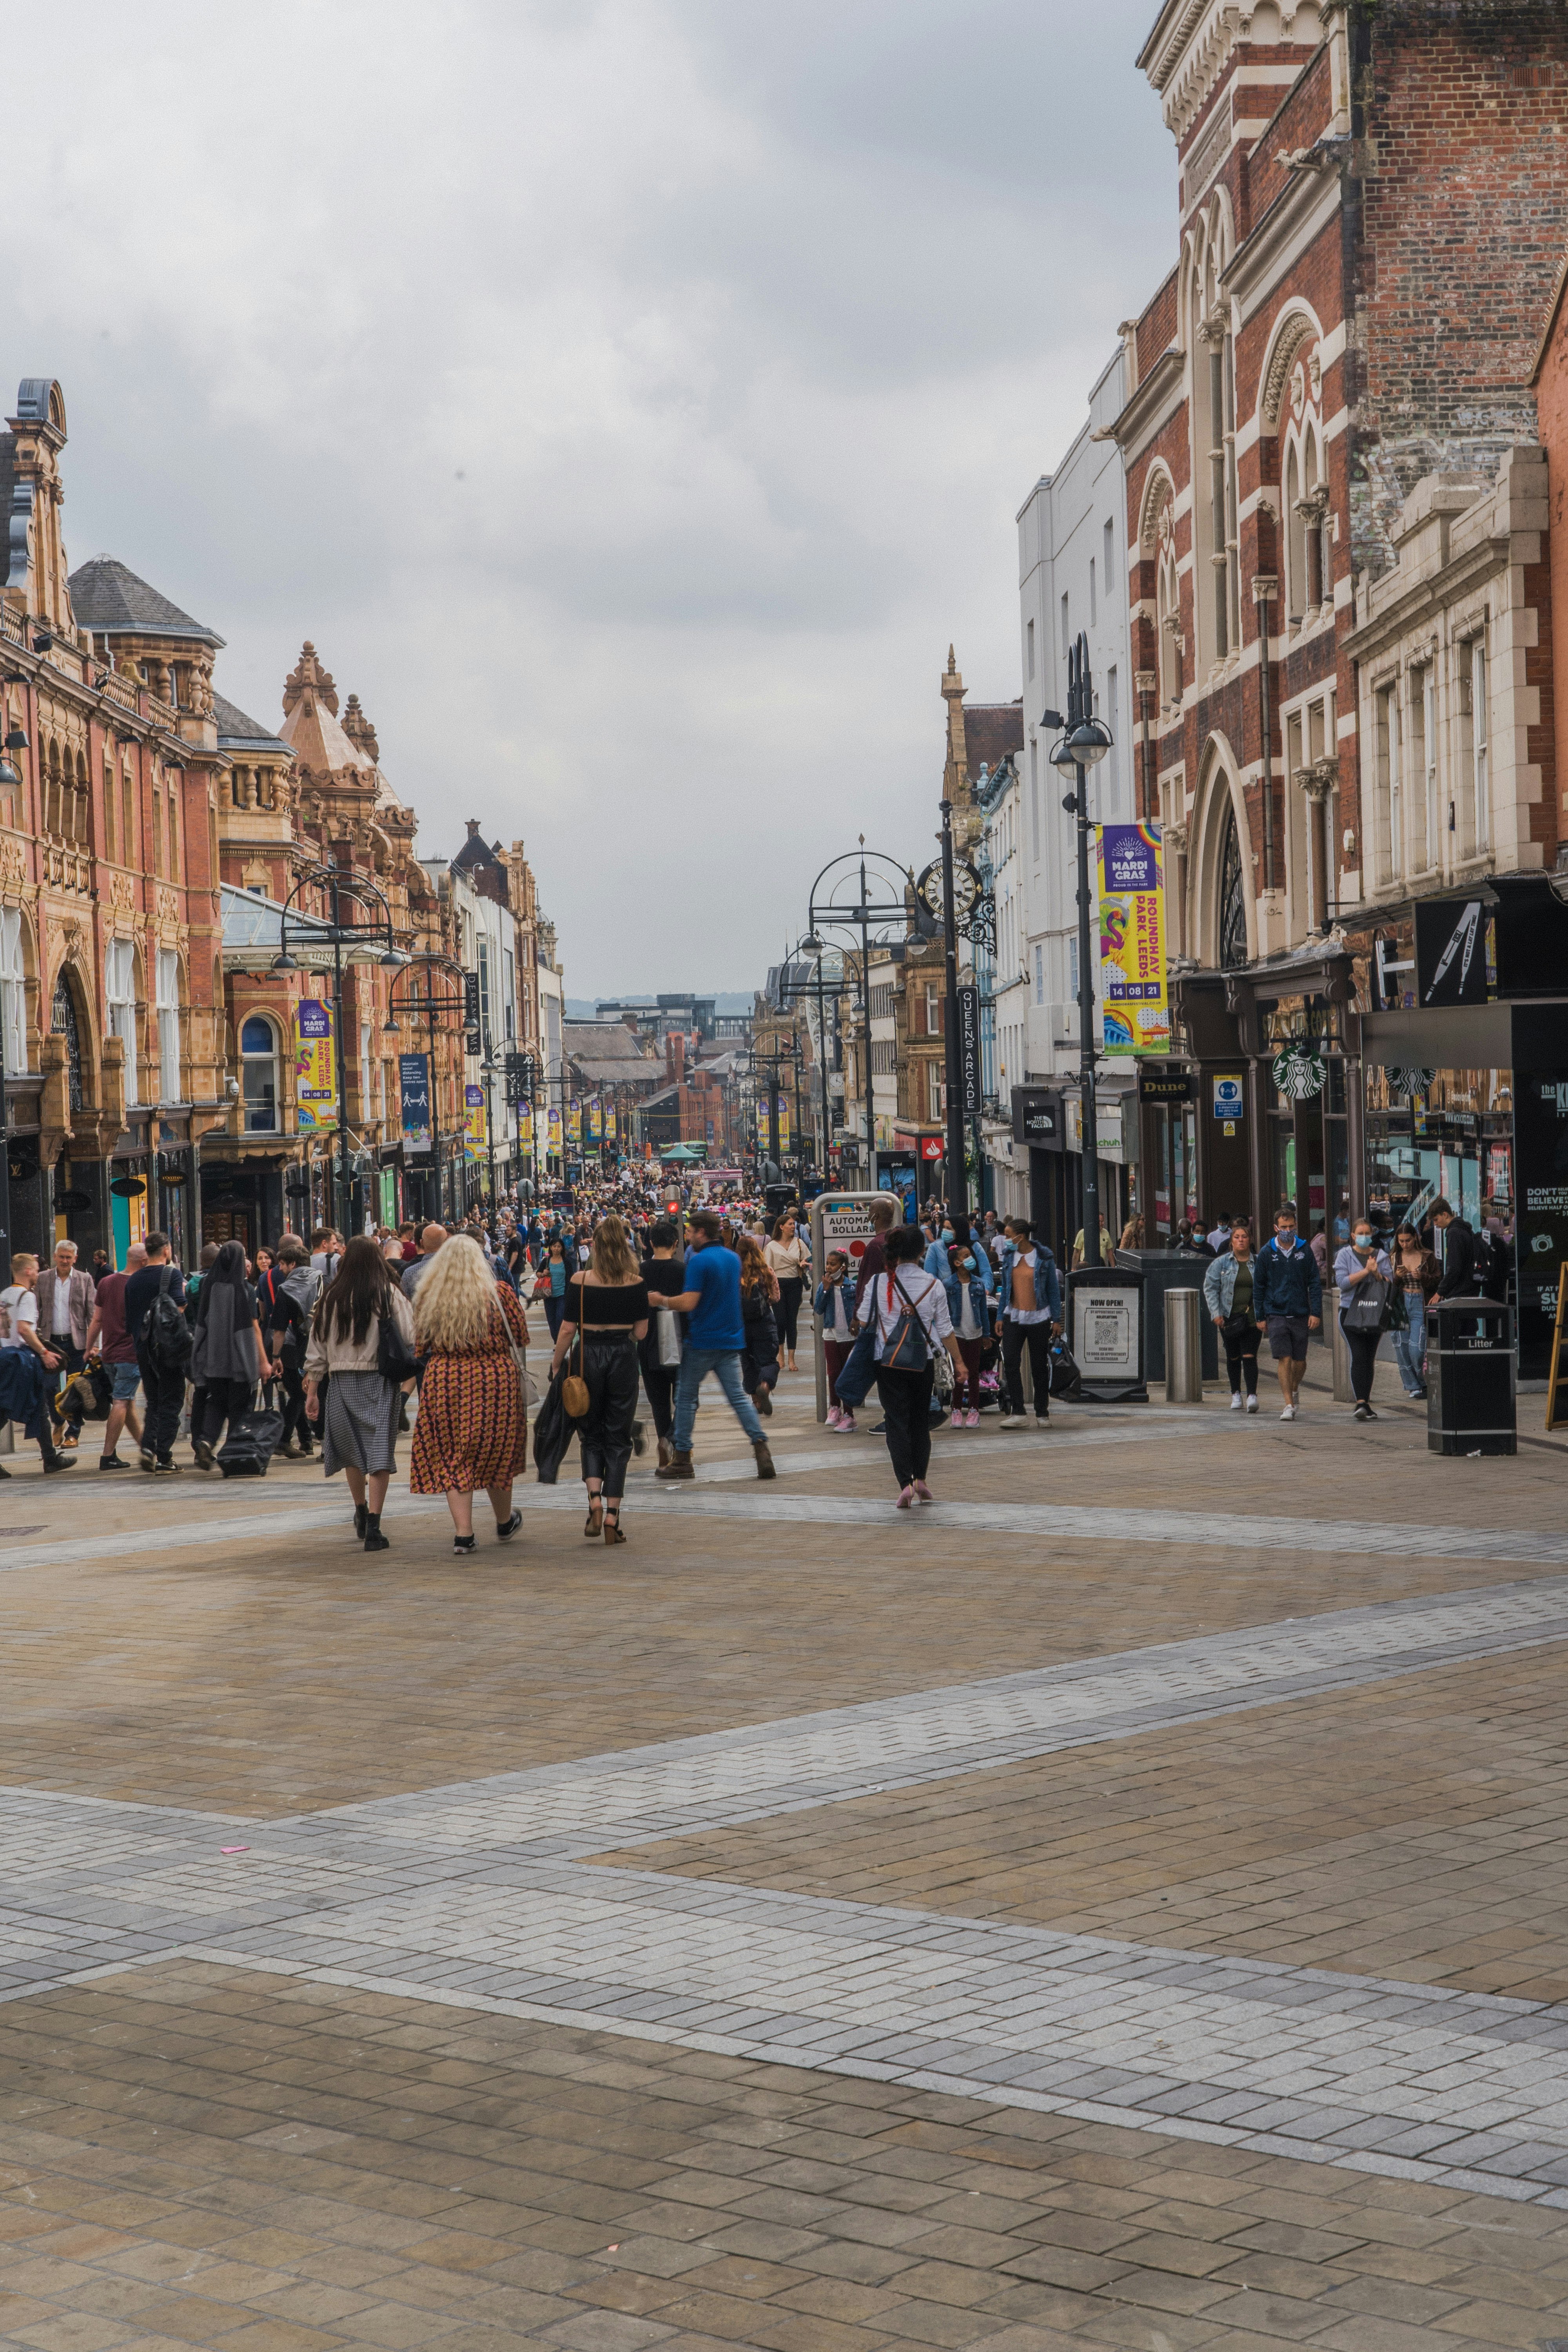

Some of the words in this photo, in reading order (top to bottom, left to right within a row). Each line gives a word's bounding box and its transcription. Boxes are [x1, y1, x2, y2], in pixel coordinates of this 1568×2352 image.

[932, 858, 966, 868] QUN'S
[1112, 861, 1147, 870] MARDI
[1115, 870, 1145, 880] GRAS
[937, 913, 966, 921] ARDE
[1136, 896, 1147, 935] PARK,
[1147, 897, 1160, 975] ROUNDHAY
[1138, 939, 1149, 978] LEEDS
[1129, 987, 1141, 995] 08
[468, 976, 477, 1052] DEBENMS
[964, 993, 974, 1048] QUEEN'S
[966, 1053, 975, 1108] ARCADE
[1144, 1082, 1186, 1092] Dune
[1542, 1085, 1555, 1094] the
[1527, 1196, 1564, 1205] BELIEVE
